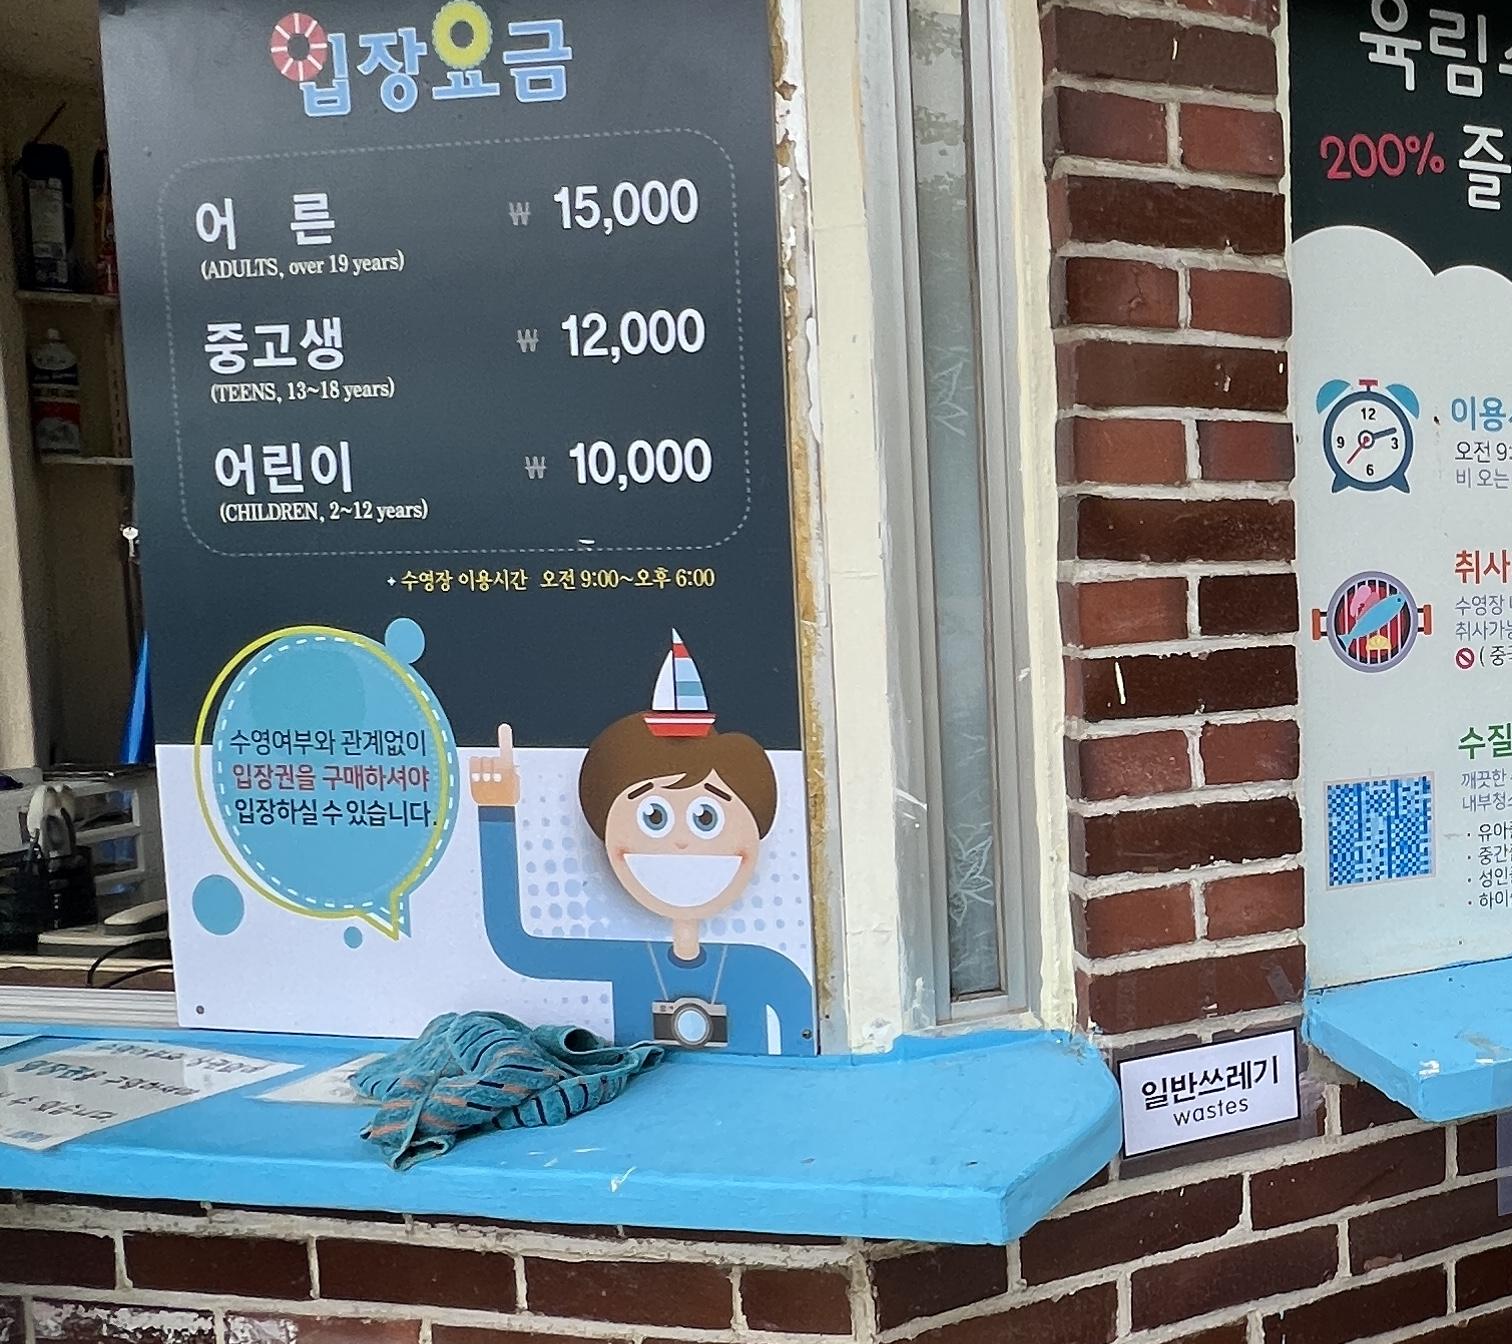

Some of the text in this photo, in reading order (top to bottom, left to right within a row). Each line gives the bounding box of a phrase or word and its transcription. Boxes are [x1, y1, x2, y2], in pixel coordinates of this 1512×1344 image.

[1319, 131, 1446, 181] 200%
[553, 178, 699, 234] 15,000
[201, 251, 404, 280] (ADULTS, over 19 years)
[204, 317, 345, 375] 중고생
[560, 309, 706, 363] 12,000
[210, 377, 395, 404] (TEENS, 13~18 years)
[1361, 408, 1376, 420] 12
[1337, 436, 1399, 449] 9 3
[1455, 442, 1491, 463] 오전
[215, 442, 352, 497] 어린이
[569, 439, 713, 490] 10,000
[1366, 464, 1374, 476] 6
[1455, 468, 1471, 489] 비
[1476, 468, 1509, 488] 오는
[220, 499, 428, 523] (CHILDREN, 2~12 years)
[401, 570, 452, 591] 수영장
[459, 570, 527, 591] 이용시간
[541, 570, 577, 590] 오전
[675, 569, 714, 587] 6:00
[1455, 594, 1503, 616] 수영장
[230, 730, 425, 756] 수영여부와 관계없이
[233, 764, 429, 791] 입장권을 구매하셔야
[1461, 768, 1506, 789] 깨끗한
[235, 799, 437, 826] 입장하실 수 있습니다.
[1142, 1055, 1278, 1110] 일반쓰레기
[1173, 1098, 1249, 1126] wastes
